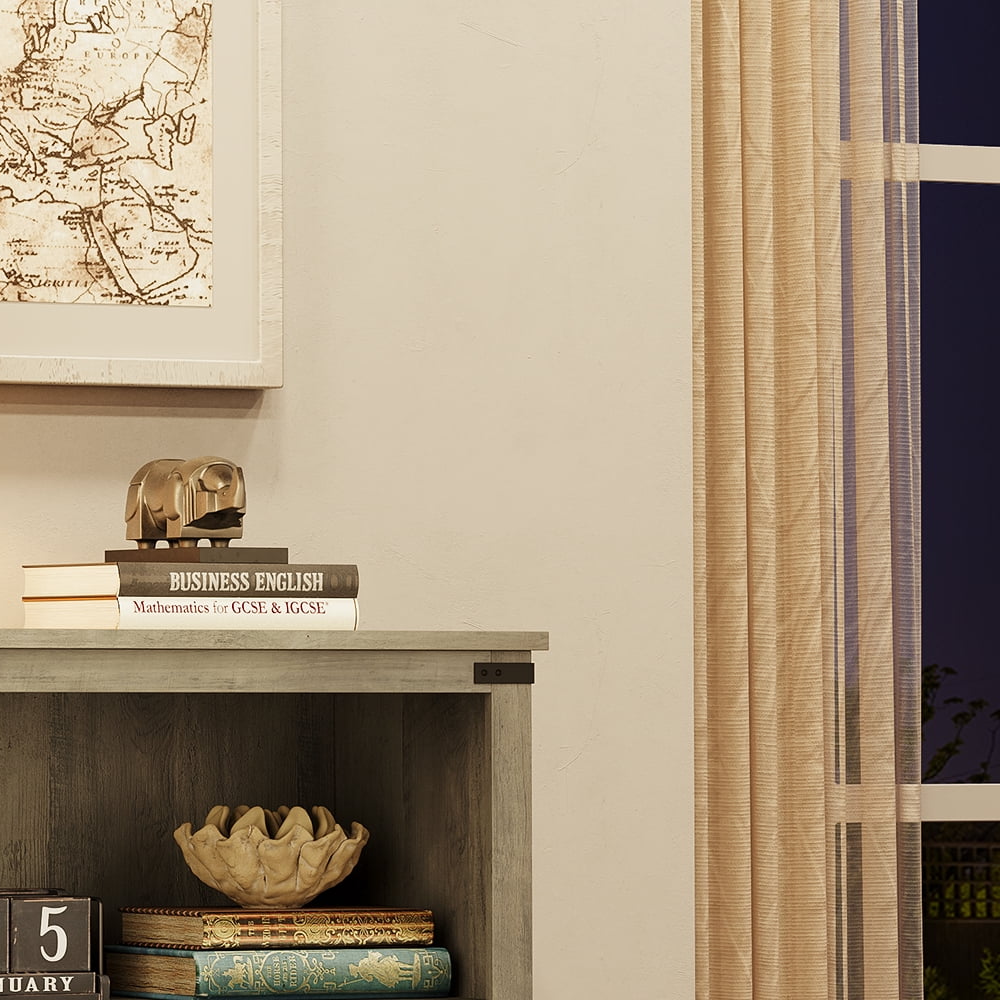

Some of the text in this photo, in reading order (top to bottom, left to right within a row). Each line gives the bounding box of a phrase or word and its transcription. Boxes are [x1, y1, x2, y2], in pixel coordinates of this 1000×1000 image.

[84, 51, 150, 60] EUROPE
[169, 571, 250, 592] BUSINESS
[254, 571, 324, 593] ENGLISH
[133, 600, 210, 615] Mathematics
[213, 600, 229, 614] for
[231, 601, 267, 615] GCSE
[271, 602, 282, 614] &
[272, 955, 281, 987] HORSE
[288, 955, 298, 987] RIDER
